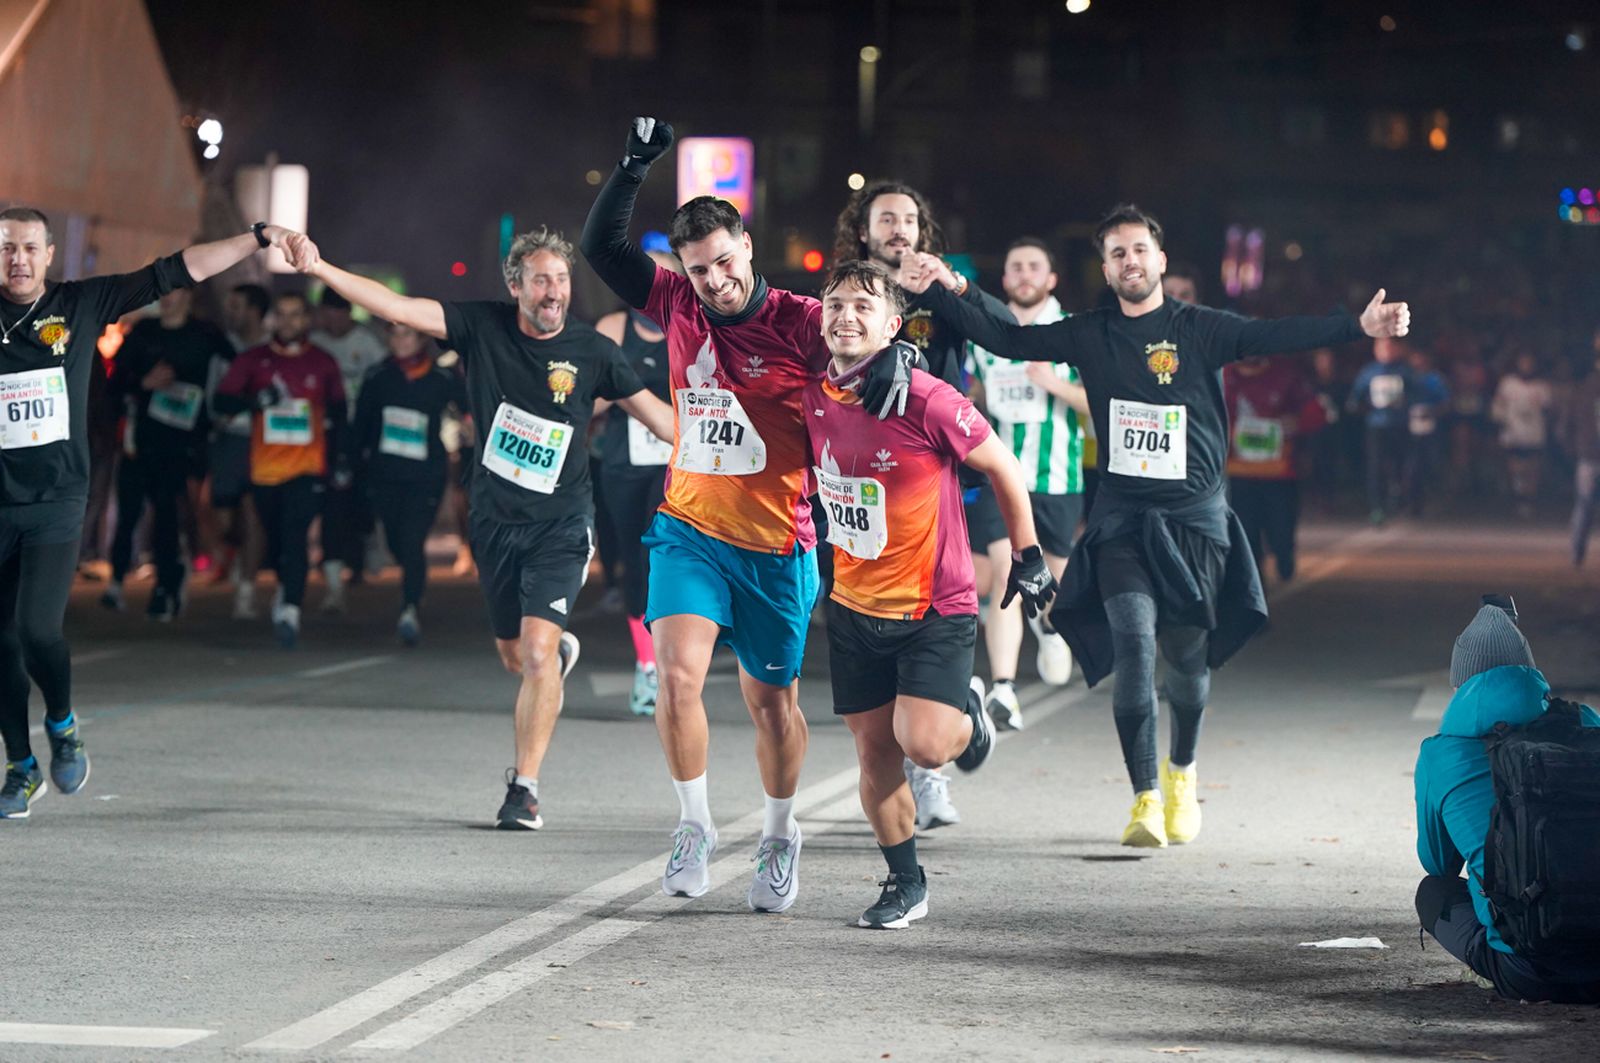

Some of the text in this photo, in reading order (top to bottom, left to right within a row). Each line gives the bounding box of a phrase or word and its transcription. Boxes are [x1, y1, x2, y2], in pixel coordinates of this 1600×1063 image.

[52, 342, 65, 356] 14
[1157, 372, 1172, 385] 14
[7, 382, 31, 391] NOCHE
[0, 391, 16, 400] SAN
[553, 392, 566, 404] 14
[697, 397, 720, 407] NOCHE
[721, 398, 733, 408] DE
[7, 397, 54, 422] 6707
[688, 407, 705, 416] SAN
[1127, 410, 1149, 419] NOCHE
[1150, 411, 1158, 420] DE
[501, 420, 516, 433] SAN
[513, 415, 535, 430] NOCHE
[1119, 417, 1133, 426] SAN
[698, 420, 745, 446] 1247
[1123, 428, 1171, 453] 6704
[498, 431, 555, 468] 12063
[826, 481, 842, 493] NOCHE
[843, 484, 853, 494] DE
[829, 501, 869, 531] 1248
